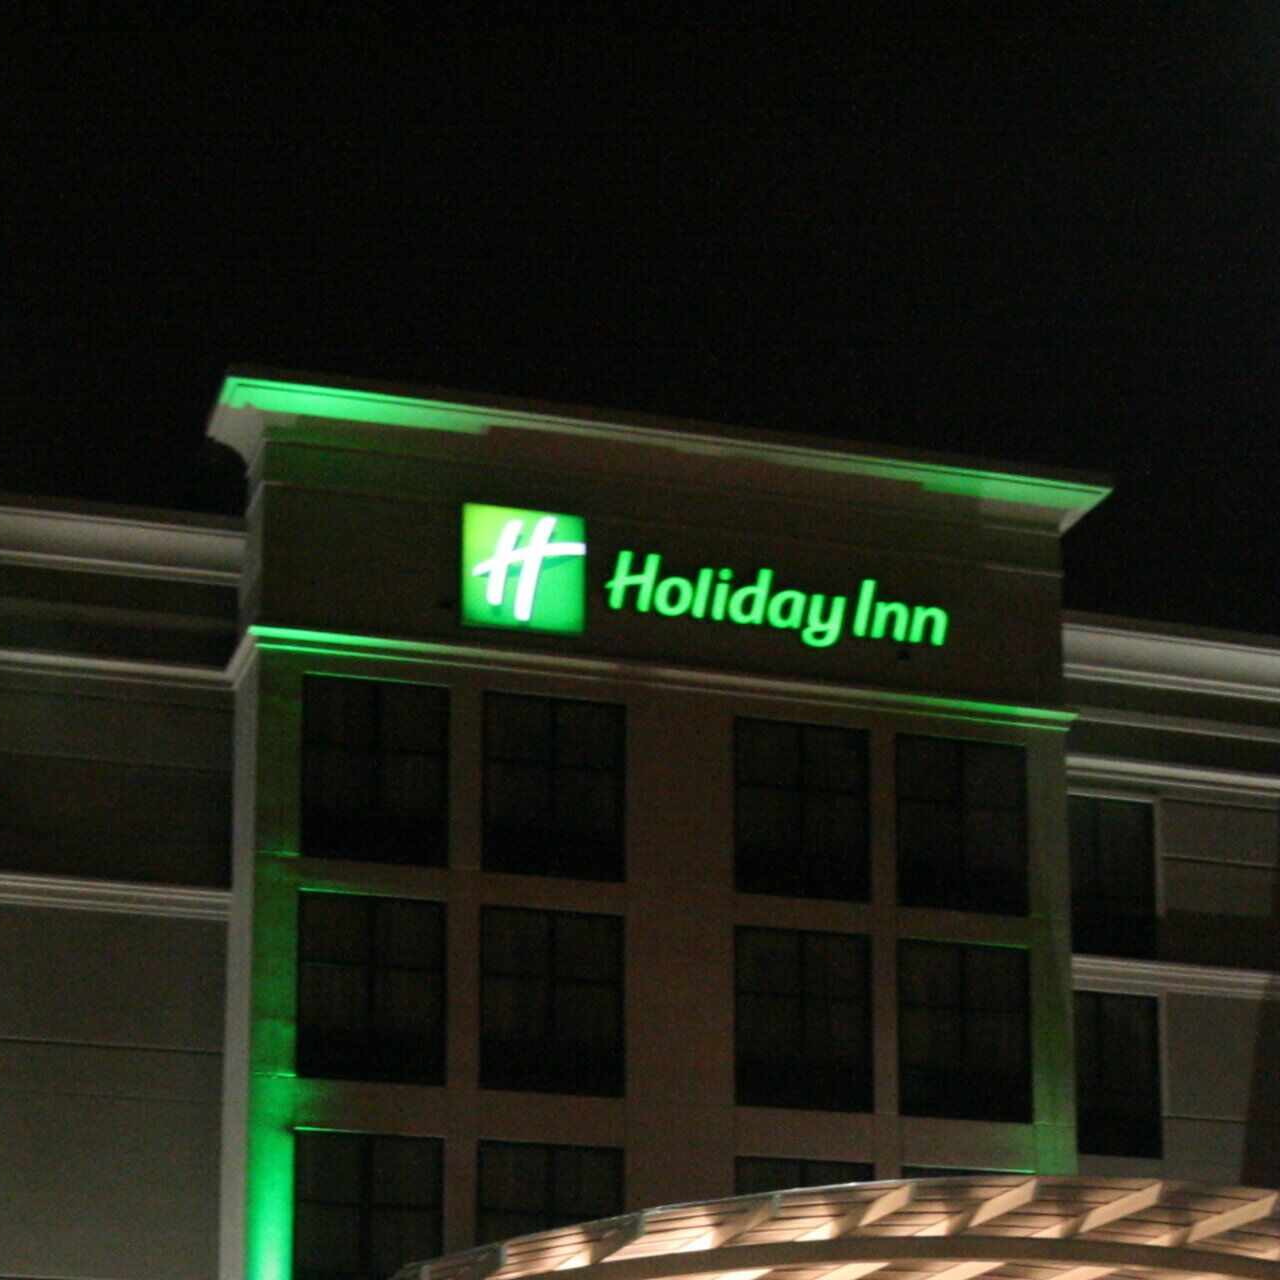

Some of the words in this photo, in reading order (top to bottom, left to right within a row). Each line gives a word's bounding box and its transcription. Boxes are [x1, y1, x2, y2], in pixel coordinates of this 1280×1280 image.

[473, 516, 587, 622] H
[605, 549, 847, 648] Holiday
[853, 578, 950, 648] Inn
